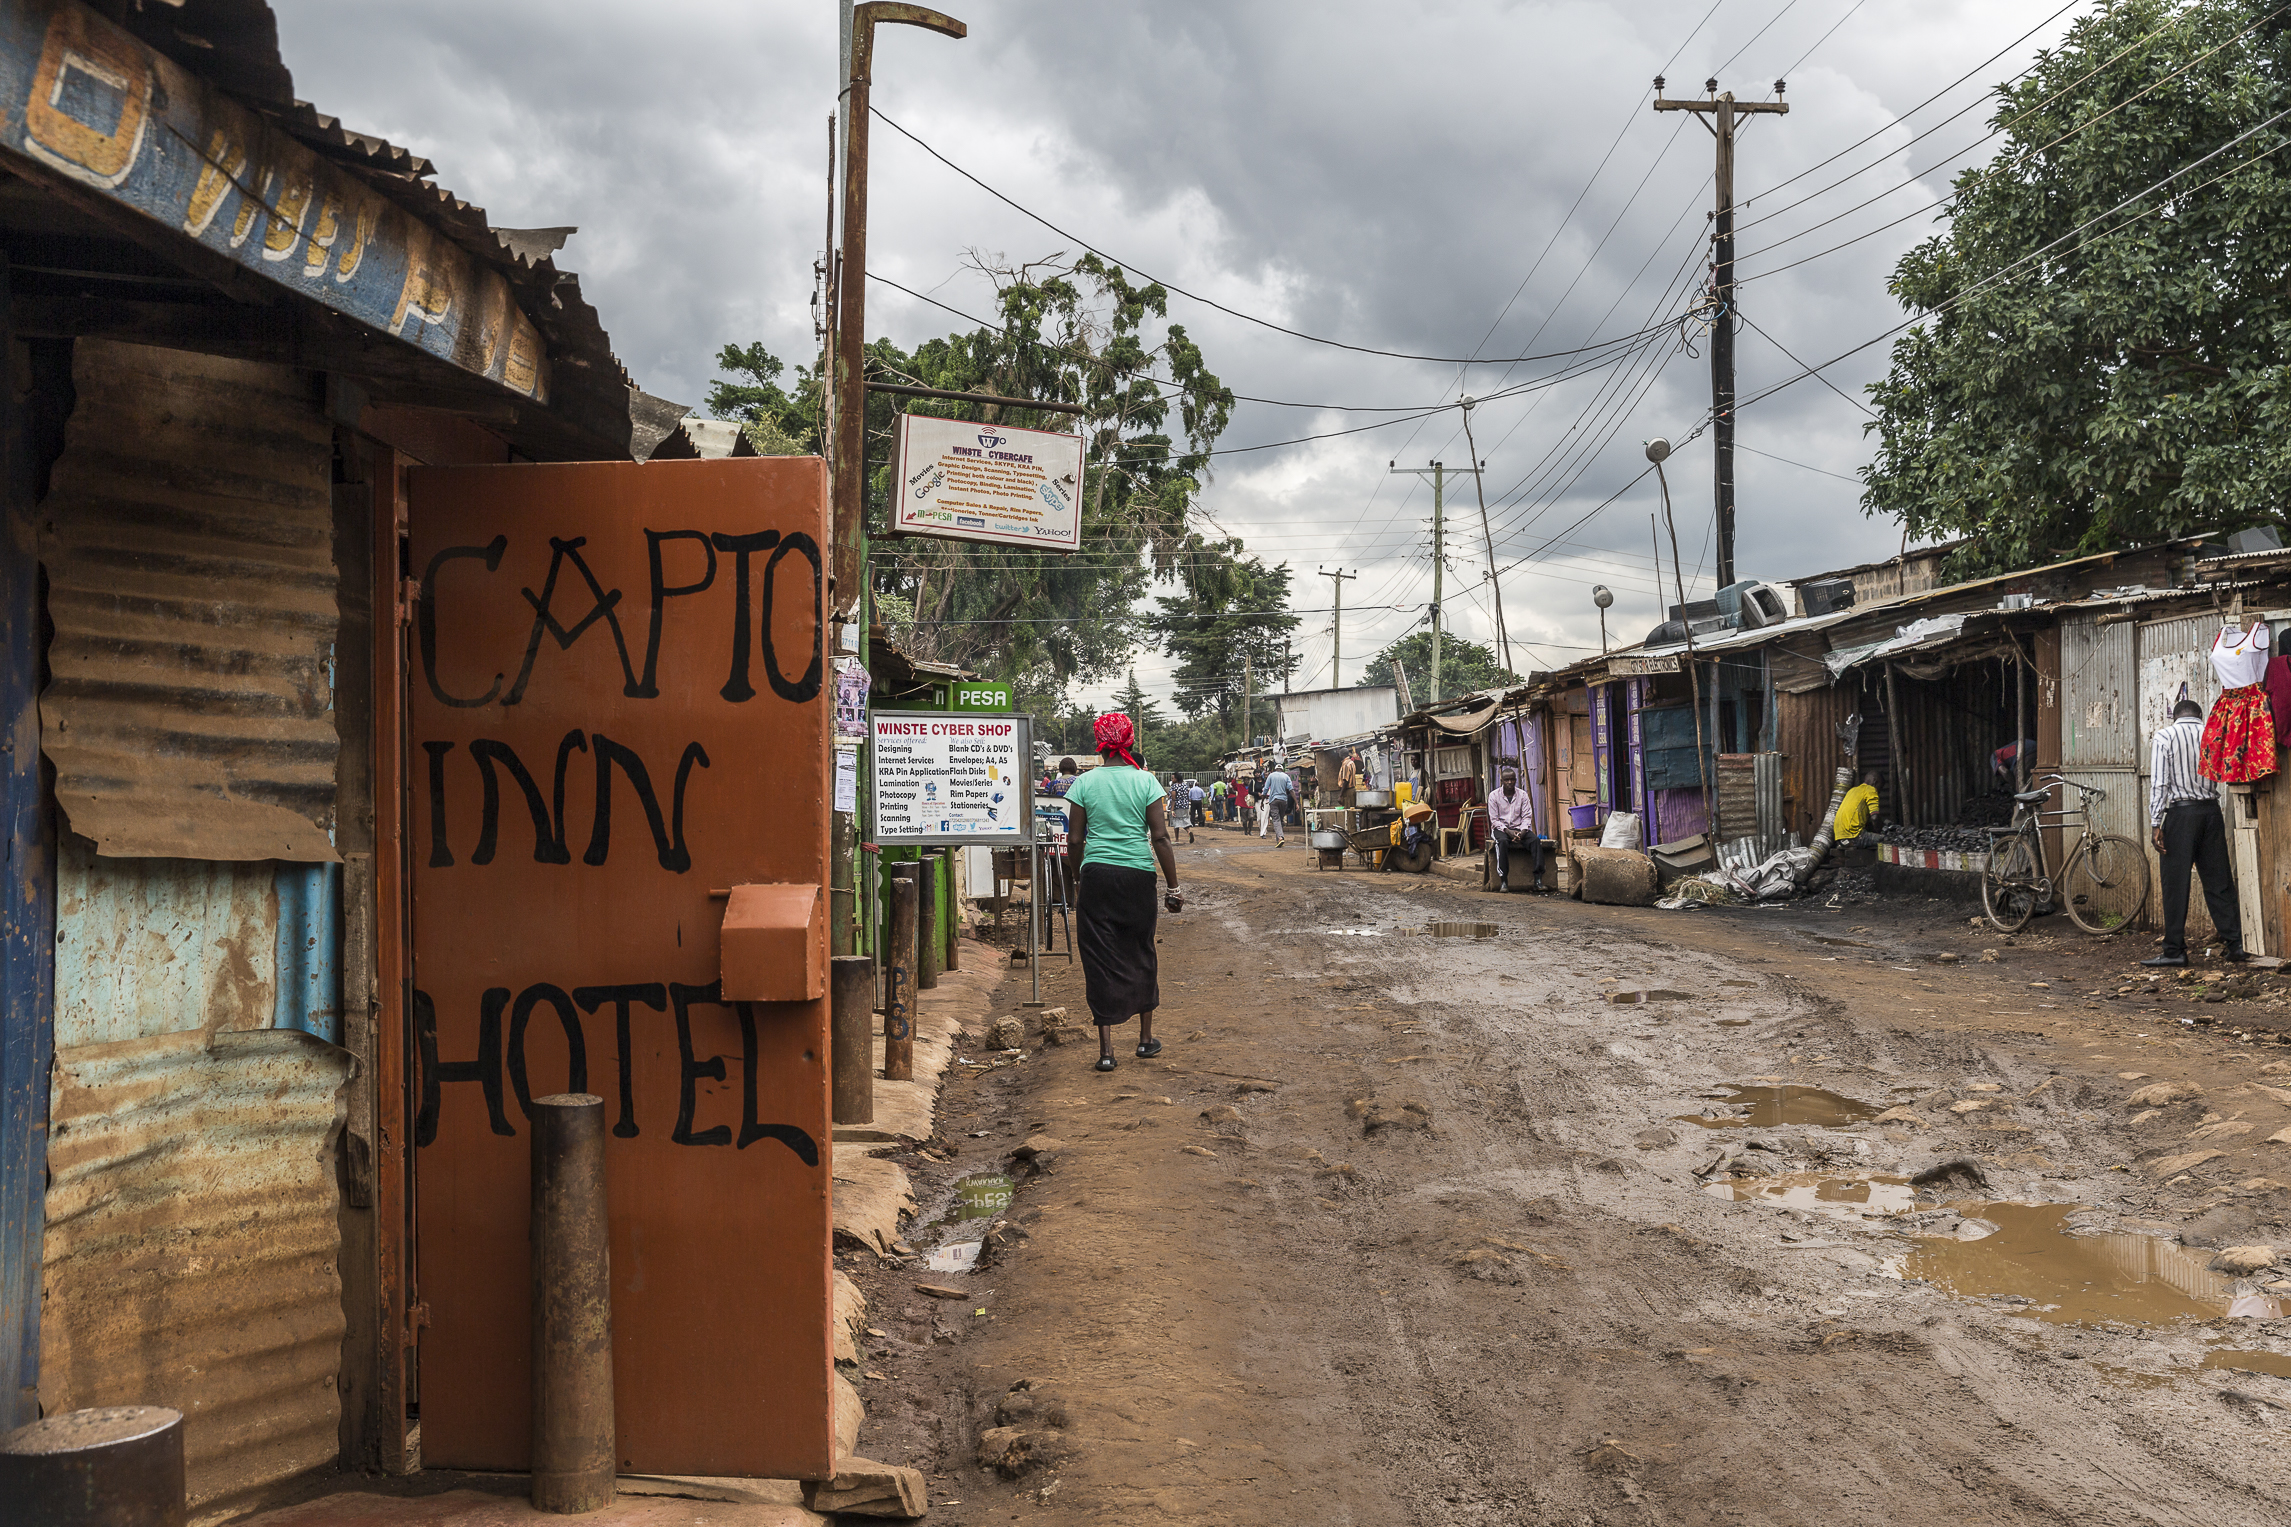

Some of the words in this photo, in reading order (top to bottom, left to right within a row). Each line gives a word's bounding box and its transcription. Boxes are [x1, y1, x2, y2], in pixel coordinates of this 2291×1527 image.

[952, 446, 982, 457] WINSTE
[989, 451, 1033, 463] CYBERCAFE
[967, 457, 992, 466] Services,
[909, 463, 934, 486] Movies
[984, 467, 1011, 476] Scanning,
[915, 471, 945, 499] Google
[947, 478, 978, 486] Photocopy,
[980, 481, 1002, 489] Binding,
[1003, 484, 1036, 493] Lamination,
[1052, 479, 1071, 502] Series
[1040, 485, 1064, 511] skype
[936, 498, 964, 506] Computer
[989, 504, 1008, 512] Repair,
[1022, 508, 1044, 516] Papers,
[959, 518, 983, 527] facebook
[995, 523, 1021, 532] twitter
[421, 528, 825, 709] CAPTO
[960, 690, 1006, 706] PESA
[877, 723, 927, 735] WINSTE
[931, 723, 974, 735] CYBER
[978, 724, 1012, 736] SHOP
[877, 736, 902, 744] Services
[903, 736, 927, 746] offered:
[960, 736, 972, 744] also
[878, 745, 912, 754] Designing
[949, 745, 969, 753] Blank
[970, 745, 985, 753] CD's
[986, 745, 992, 753] &
[993, 745, 1013, 753] DVD's
[878, 756, 906, 764] Internet
[908, 756, 934, 764] Services
[949, 756, 984, 765] Envelopes;
[985, 756, 997, 765] A4,
[998, 756, 1008, 764] A5
[879, 767, 894, 775] KRA
[896, 767, 908, 775] Pin
[909, 767, 949, 777] Application
[949, 767, 967, 775] Flash
[969, 767, 986, 775] Disks
[879, 779, 920, 787] Lamination
[949, 778, 993, 787] Movies/Series
[879, 791, 916, 800] Photocopy
[950, 789, 964, 798] Rim
[965, 789, 989, 799] Papers
[422, 728, 710, 875] INN
[950, 801, 989, 810] Stationeries
[880, 802, 908, 811] Printing
[880, 814, 911, 823] Scanning
[880, 826, 898, 834] Type
[899, 825, 923, 834] Setting
[416, 980, 820, 1167] HOTEL
